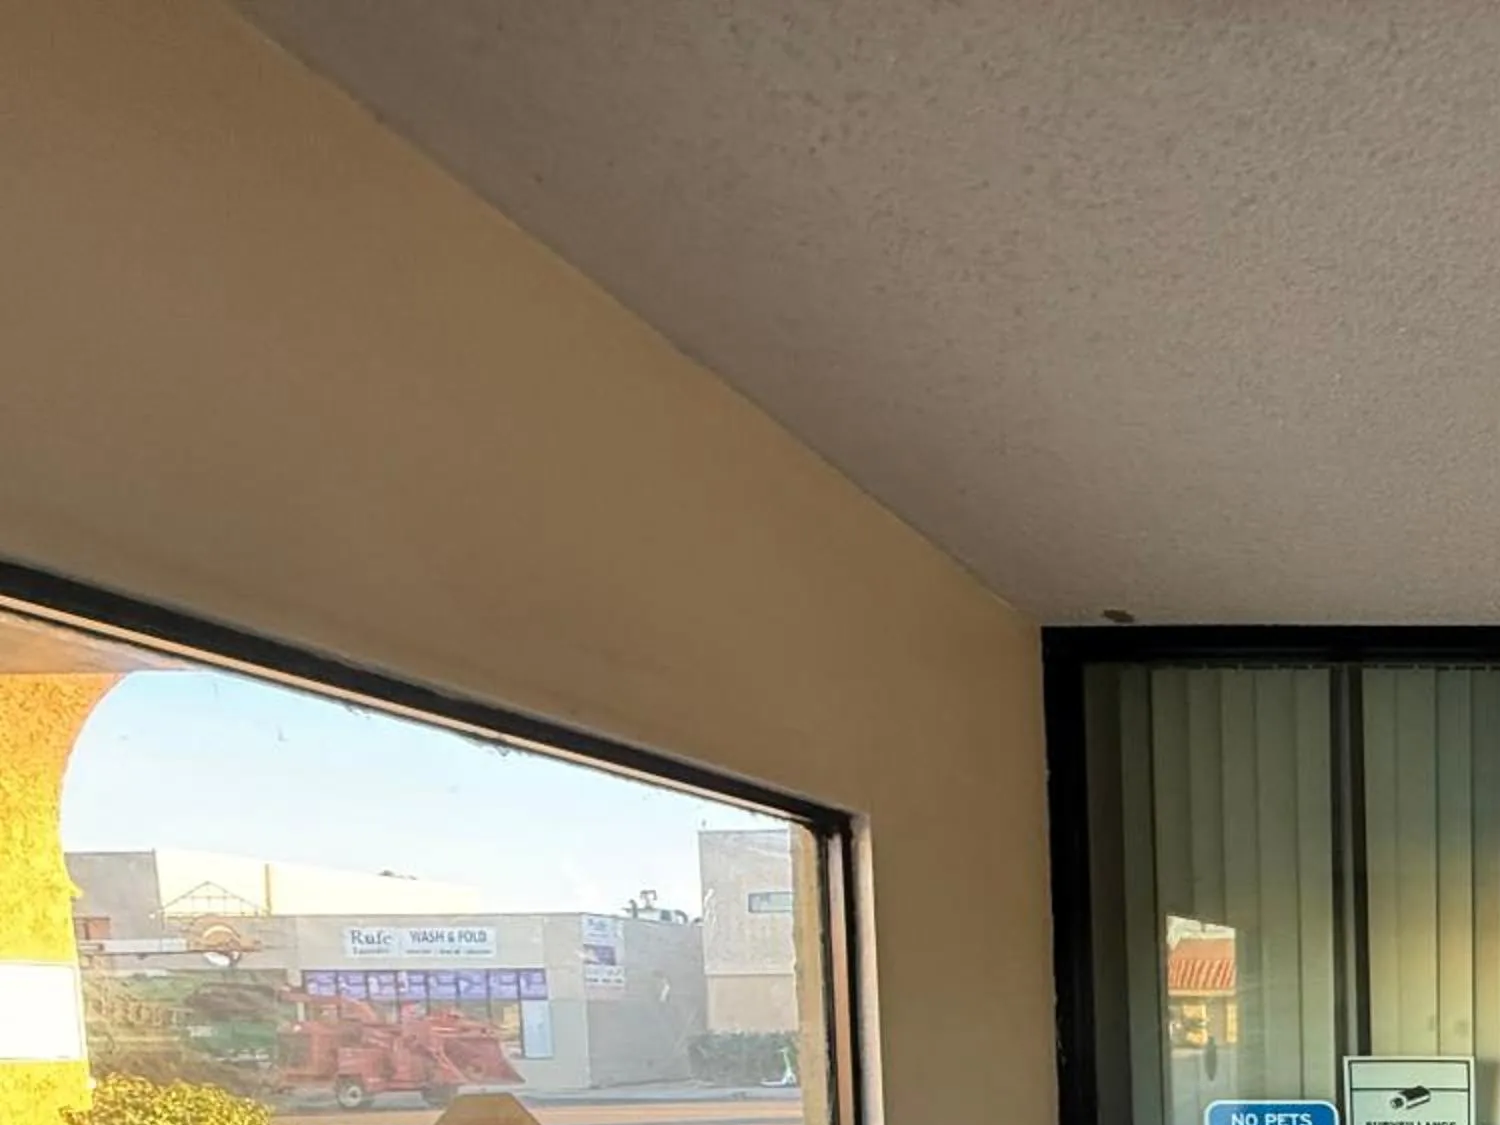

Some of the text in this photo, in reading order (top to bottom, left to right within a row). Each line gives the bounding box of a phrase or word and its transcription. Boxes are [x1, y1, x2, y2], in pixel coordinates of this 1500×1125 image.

[408, 930, 488, 944] WASH & FOLD
